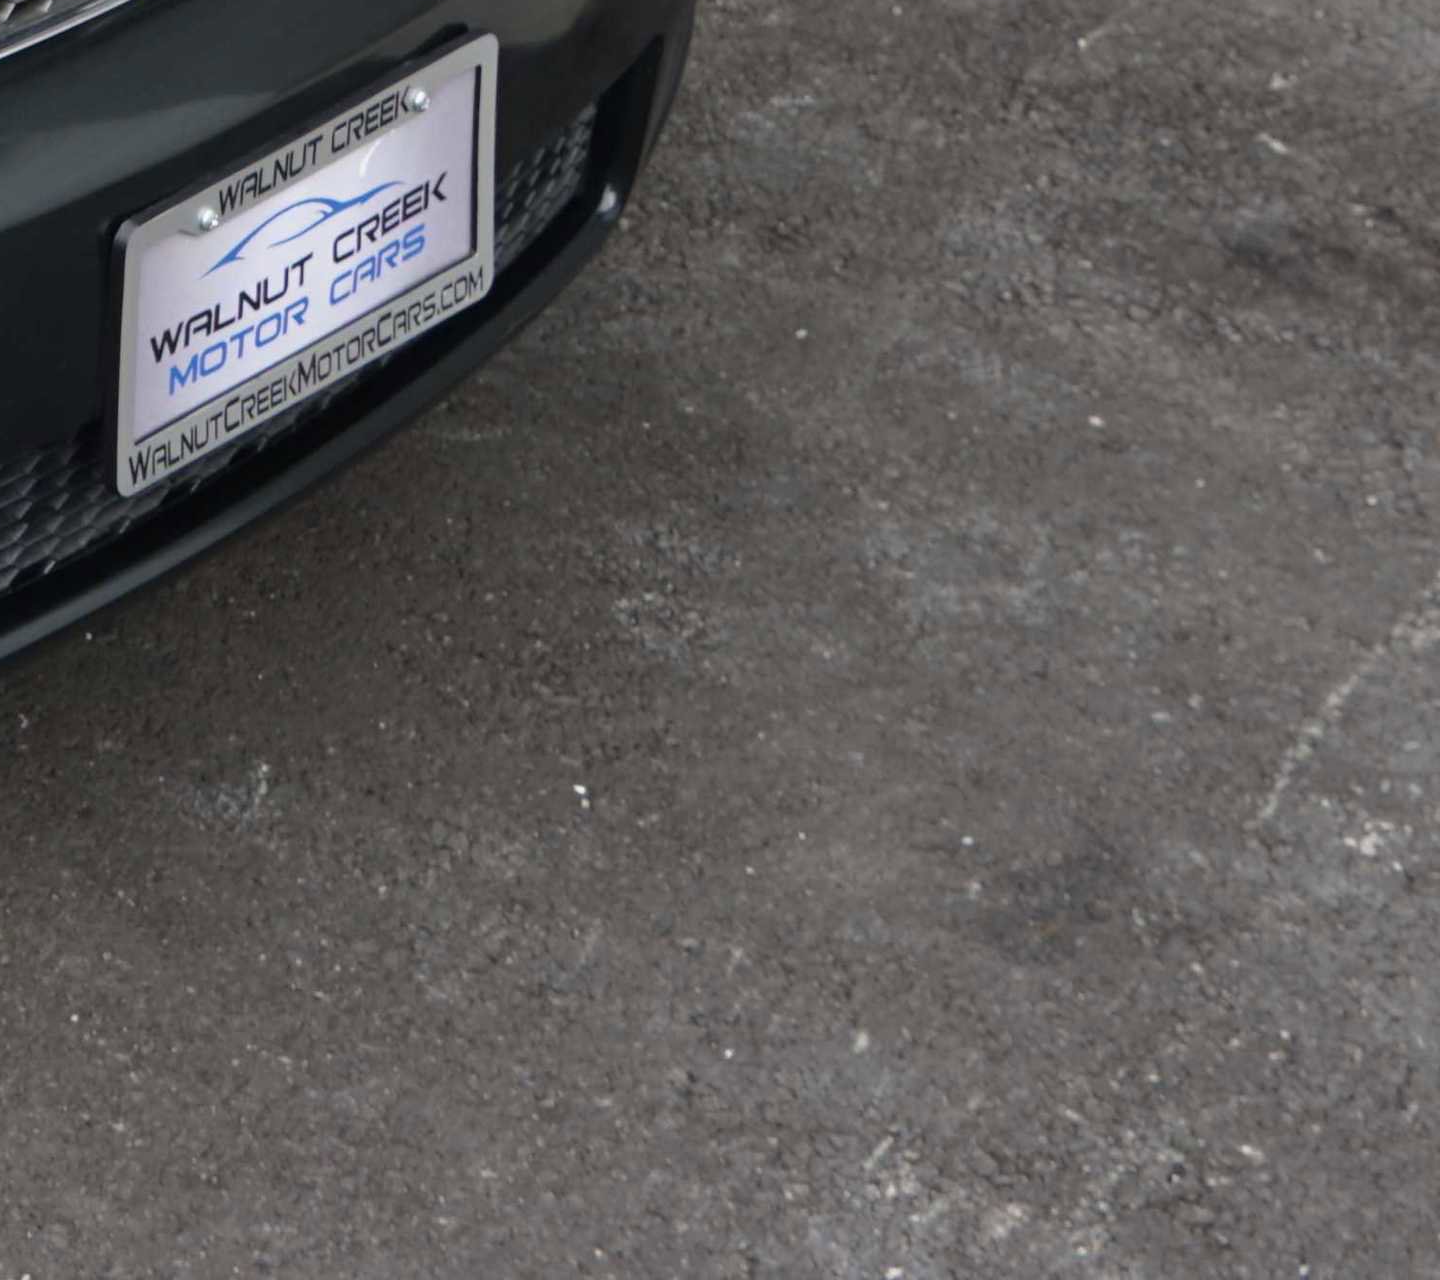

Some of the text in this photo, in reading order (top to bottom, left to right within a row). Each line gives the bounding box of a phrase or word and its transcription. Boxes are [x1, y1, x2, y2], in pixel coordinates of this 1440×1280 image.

[218, 85, 411, 215] WALNUT CREEK
[149, 171, 449, 365] WALNUT CREEK
[168, 224, 427, 396] MOTOR CARS
